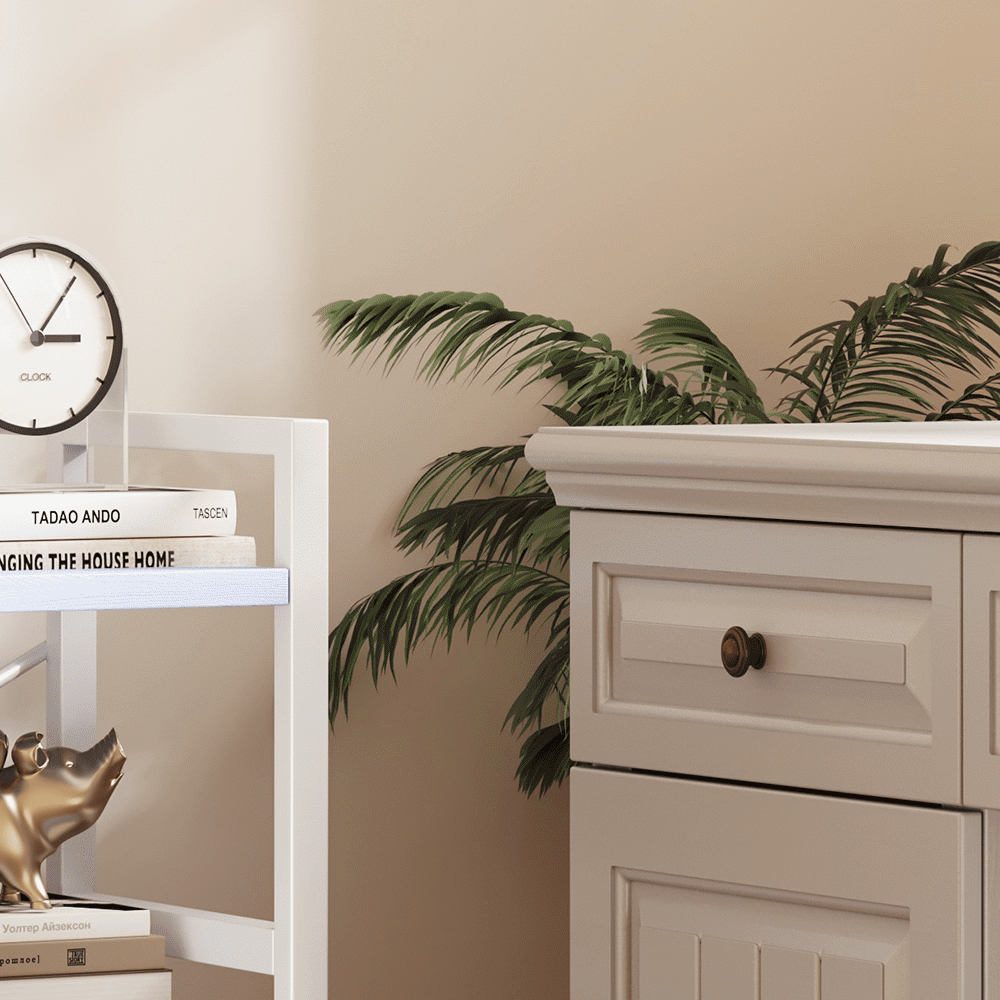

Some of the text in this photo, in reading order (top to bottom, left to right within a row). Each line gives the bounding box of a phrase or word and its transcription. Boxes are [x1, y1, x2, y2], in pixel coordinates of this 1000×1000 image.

[20, 373, 52, 382] CLOCK
[31, 509, 121, 525] TADAO ANDO
[193, 508, 228, 519] TASCEN
[49, 553, 77, 570] THE
[82, 552, 129, 569] HOUSE
[134, 551, 175, 568] HOME
[3, 923, 39, 934] Уолтер
[42, 921, 91, 932] Айзексон
